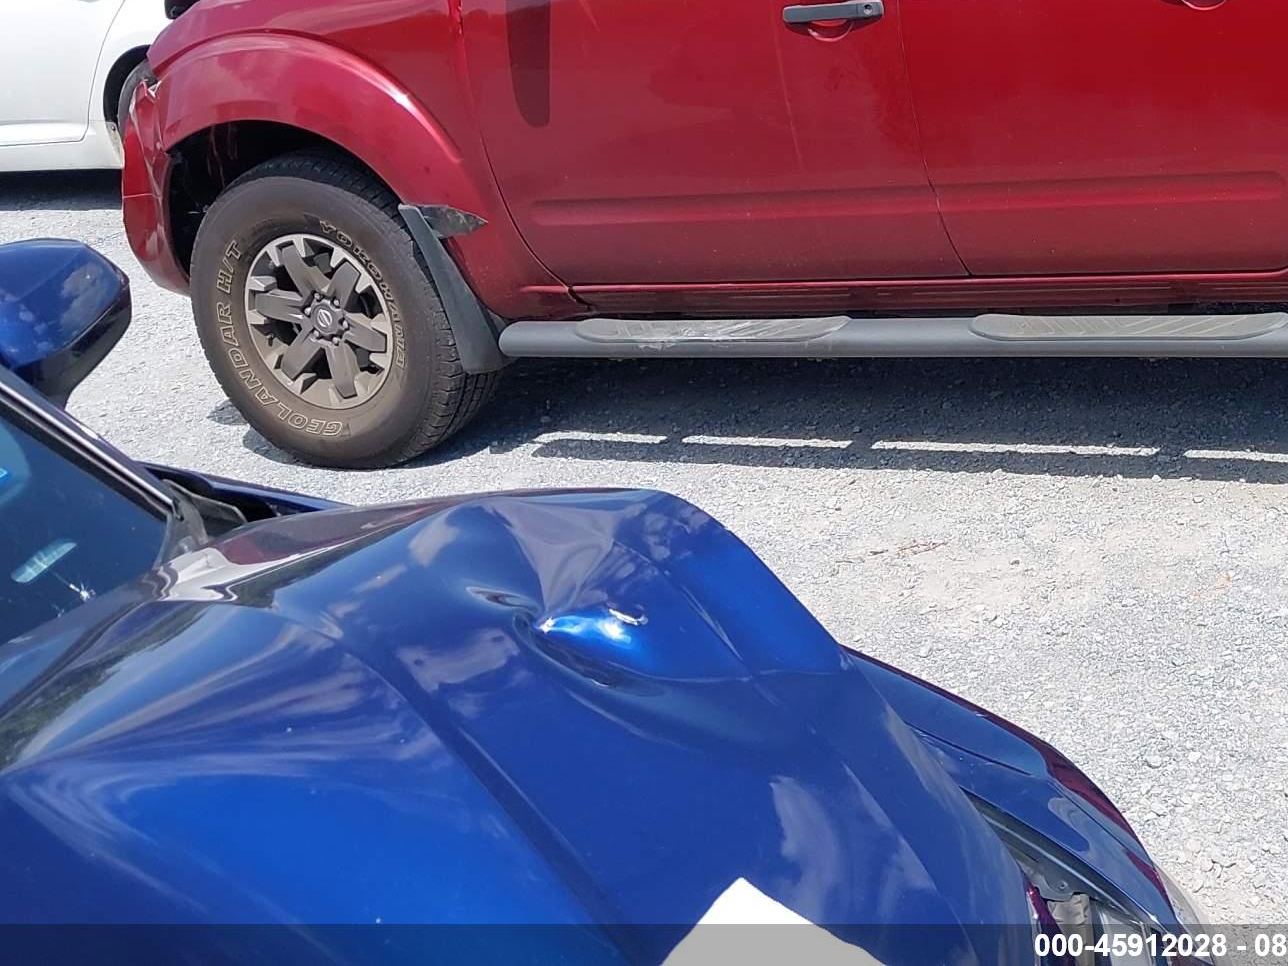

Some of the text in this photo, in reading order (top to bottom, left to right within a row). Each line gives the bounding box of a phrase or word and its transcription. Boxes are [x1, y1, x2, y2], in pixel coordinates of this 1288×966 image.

[216, 240, 344, 436] GEOLANDAR H/T
[319, 220, 408, 372] YOKOHAMA
